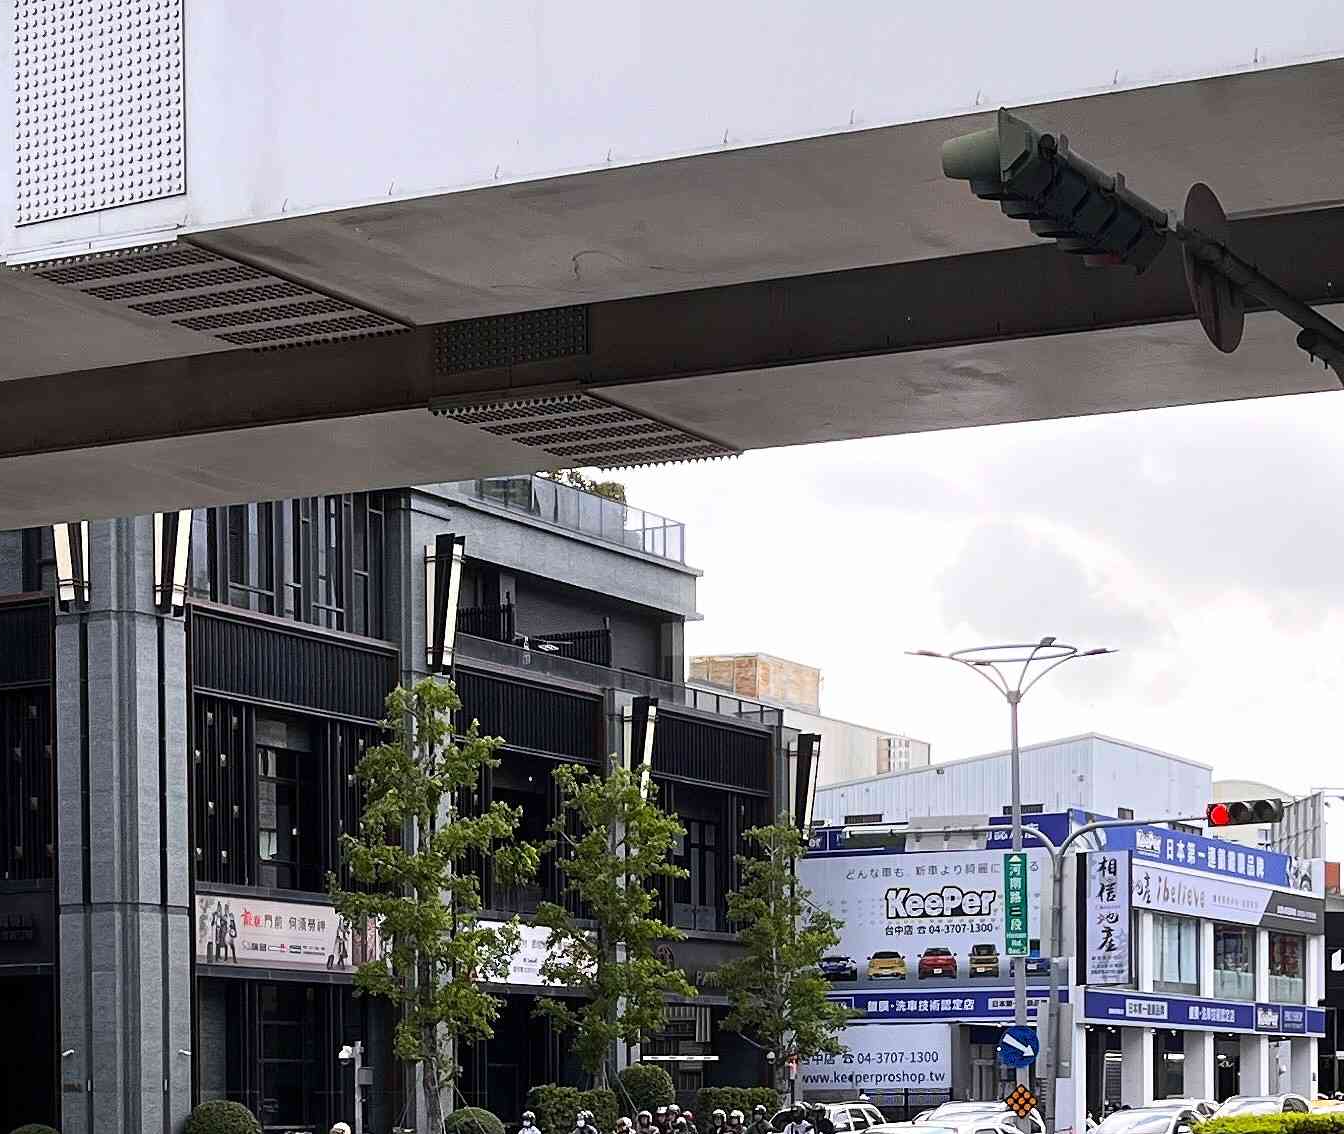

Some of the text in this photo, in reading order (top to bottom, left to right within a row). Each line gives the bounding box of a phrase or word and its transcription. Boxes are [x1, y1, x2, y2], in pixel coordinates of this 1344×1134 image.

[885, 886, 996, 919] KeePer
[928, 923, 993, 935] 04-3707-1300
[857, 1051, 939, 1064] 04-3707-1300
[803, 1070, 945, 1086] www.keperproshop.tw
